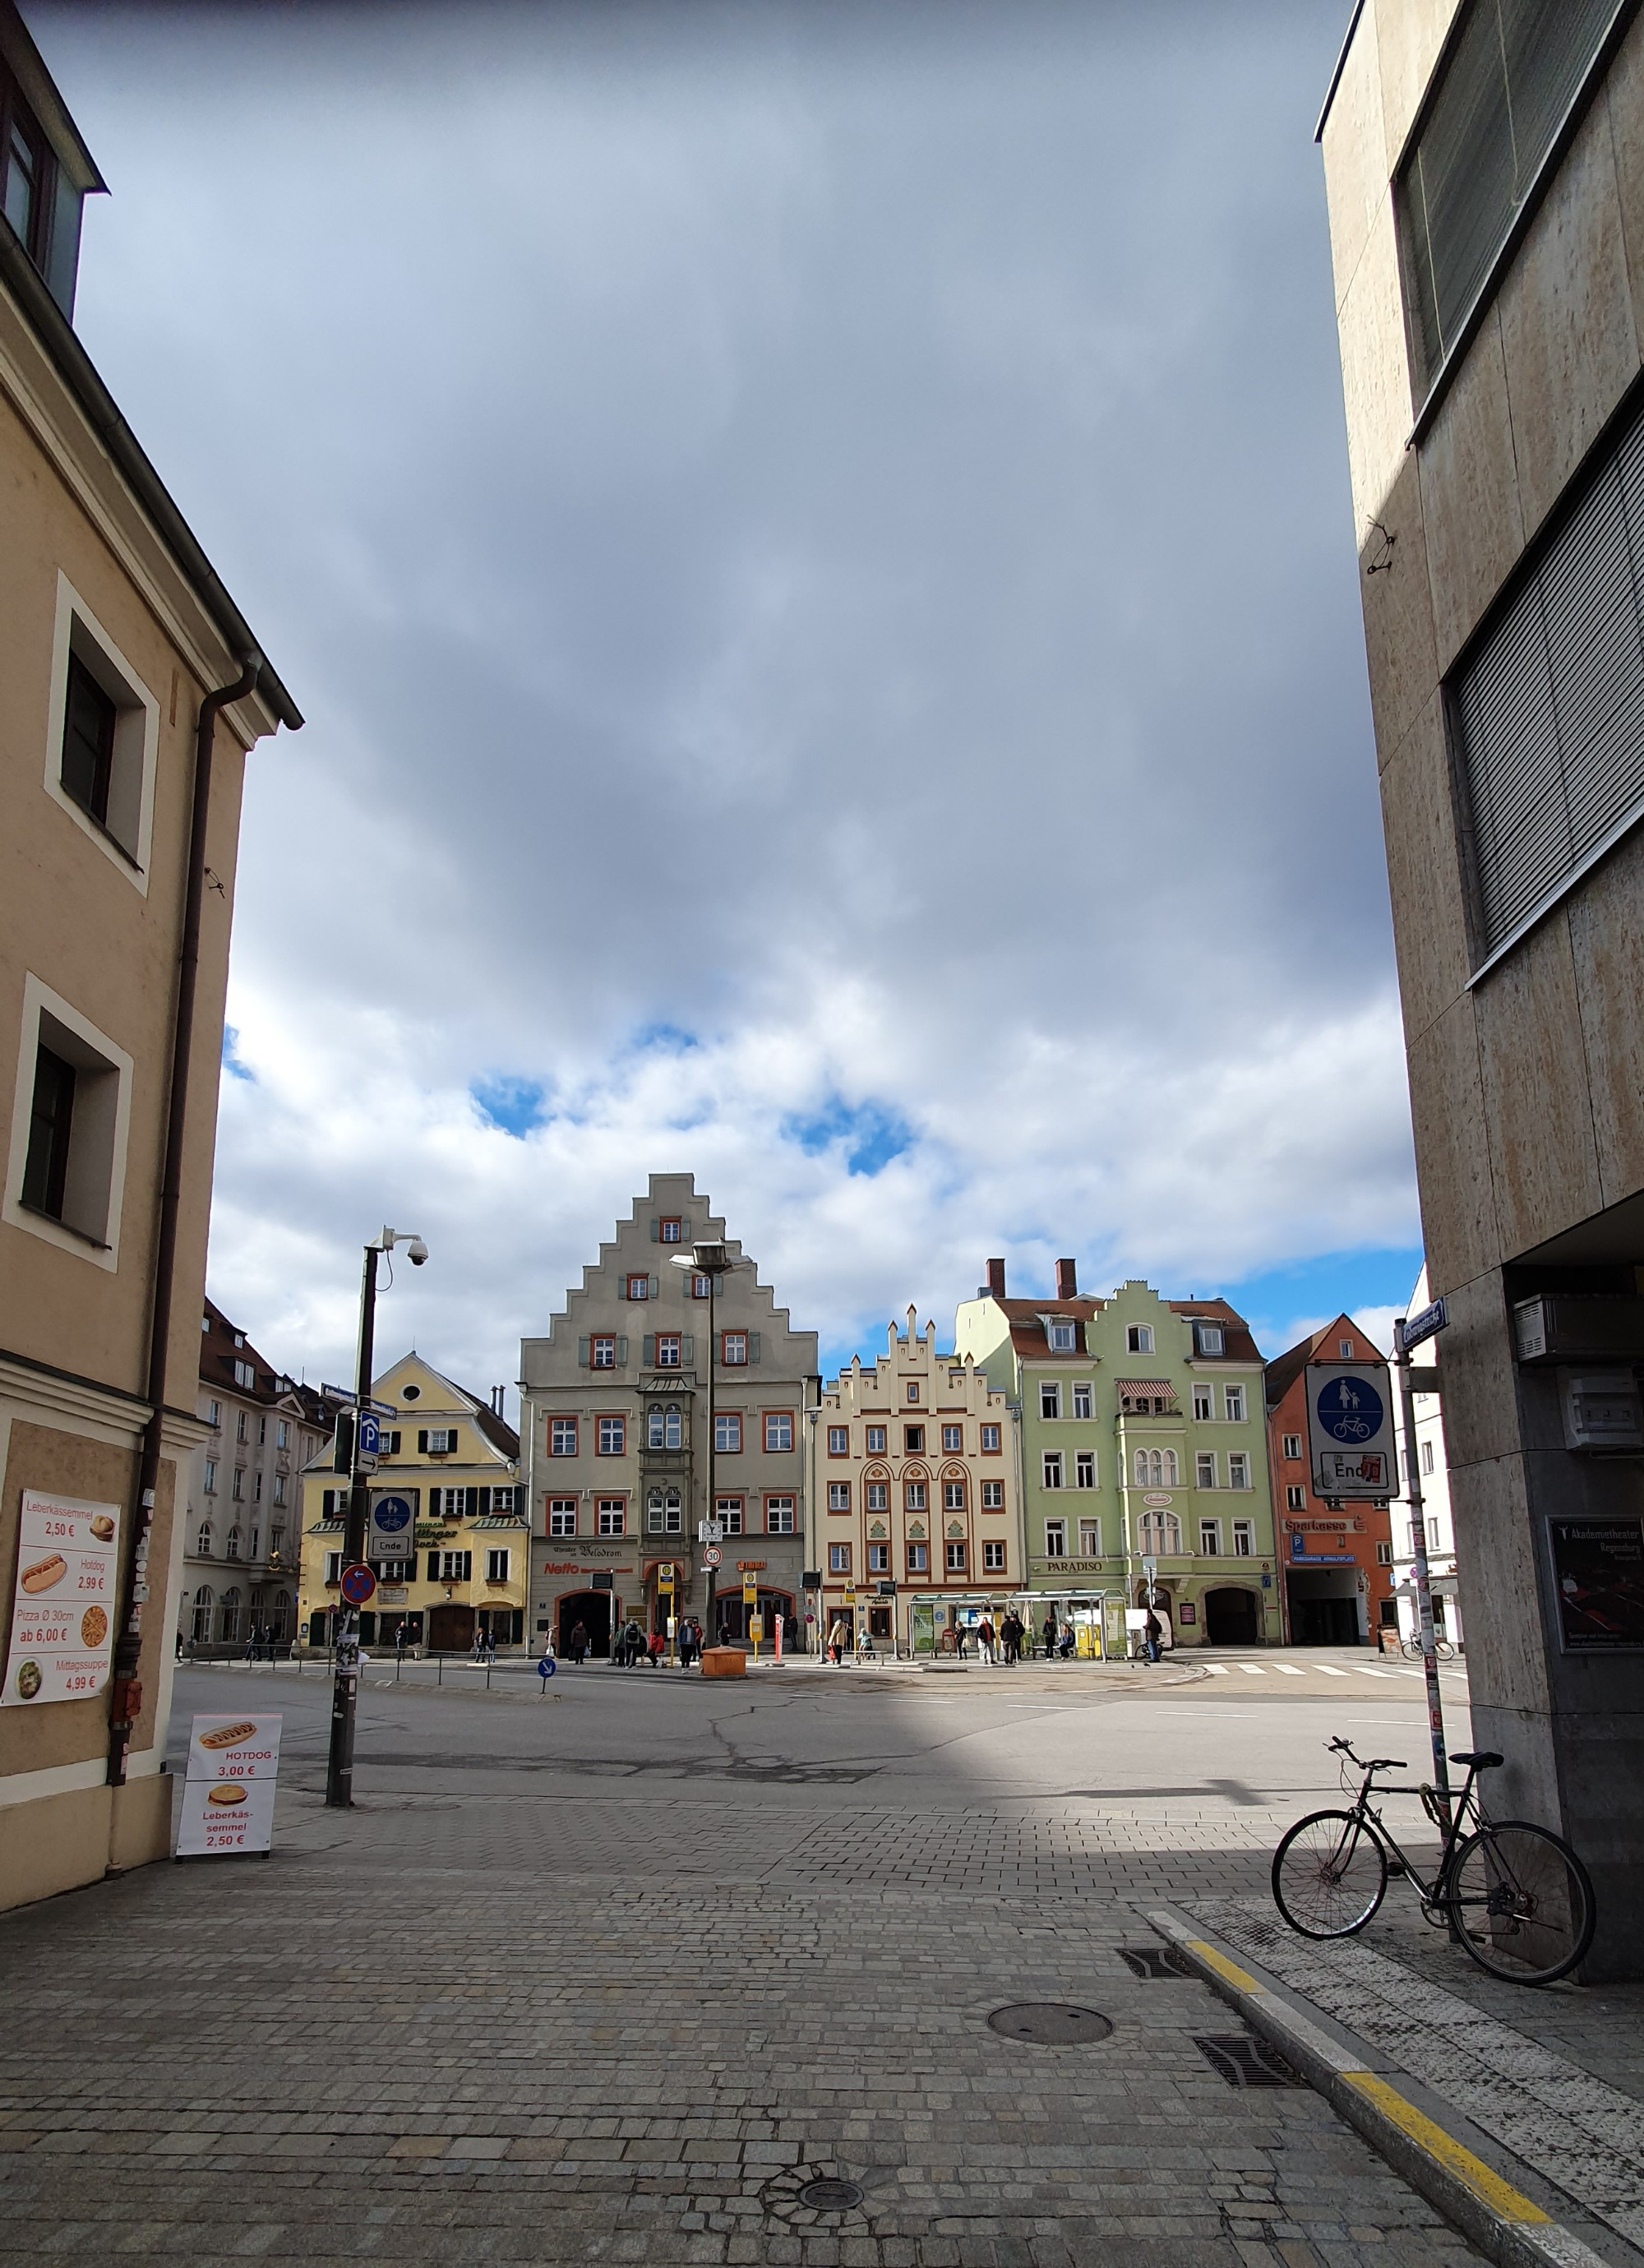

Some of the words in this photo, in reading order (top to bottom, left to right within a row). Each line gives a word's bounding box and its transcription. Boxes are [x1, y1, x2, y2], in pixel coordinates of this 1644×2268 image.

[367, 1426, 375, 1448] P
[26, 1500, 94, 1521] Leberkässemmel
[45, 1522, 66, 1537] 2,50
[68, 1524, 75, 1537] €
[1286, 1519, 1347, 1532] Sparkasse
[380, 1542, 401, 1550] Ende
[708, 1552, 718, 1560] 30
[81, 1559, 105, 1573] Hotdog
[544, 1562, 579, 1574] Netto
[1047, 1562, 1102, 1571] PARADISO
[78, 1577, 96, 1591] 2,99
[98, 1577, 104, 1589] €
[17, 1609, 39, 1621] Pizza
[52, 1610, 74, 1621] 30cm
[20, 1629, 33, 1642] ab
[36, 1628, 58, 1643] 6,00
[61, 1628, 67, 1642] €
[56, 1659, 109, 1671] Mittagssuppe
[66, 1675, 86, 1691] 4,99
[89, 1675, 95, 1688] €
[226, 1751, 271, 1760] HOTDOG
[218, 1766, 243, 1776] 3,00
[247, 1766, 255, 1776] €
[202, 1810, 253, 1820] Leberkäs-
[206, 1822, 247, 1831] semmel
[206, 1836, 233, 1847] 2,50
[237, 1835, 244, 1845] €
